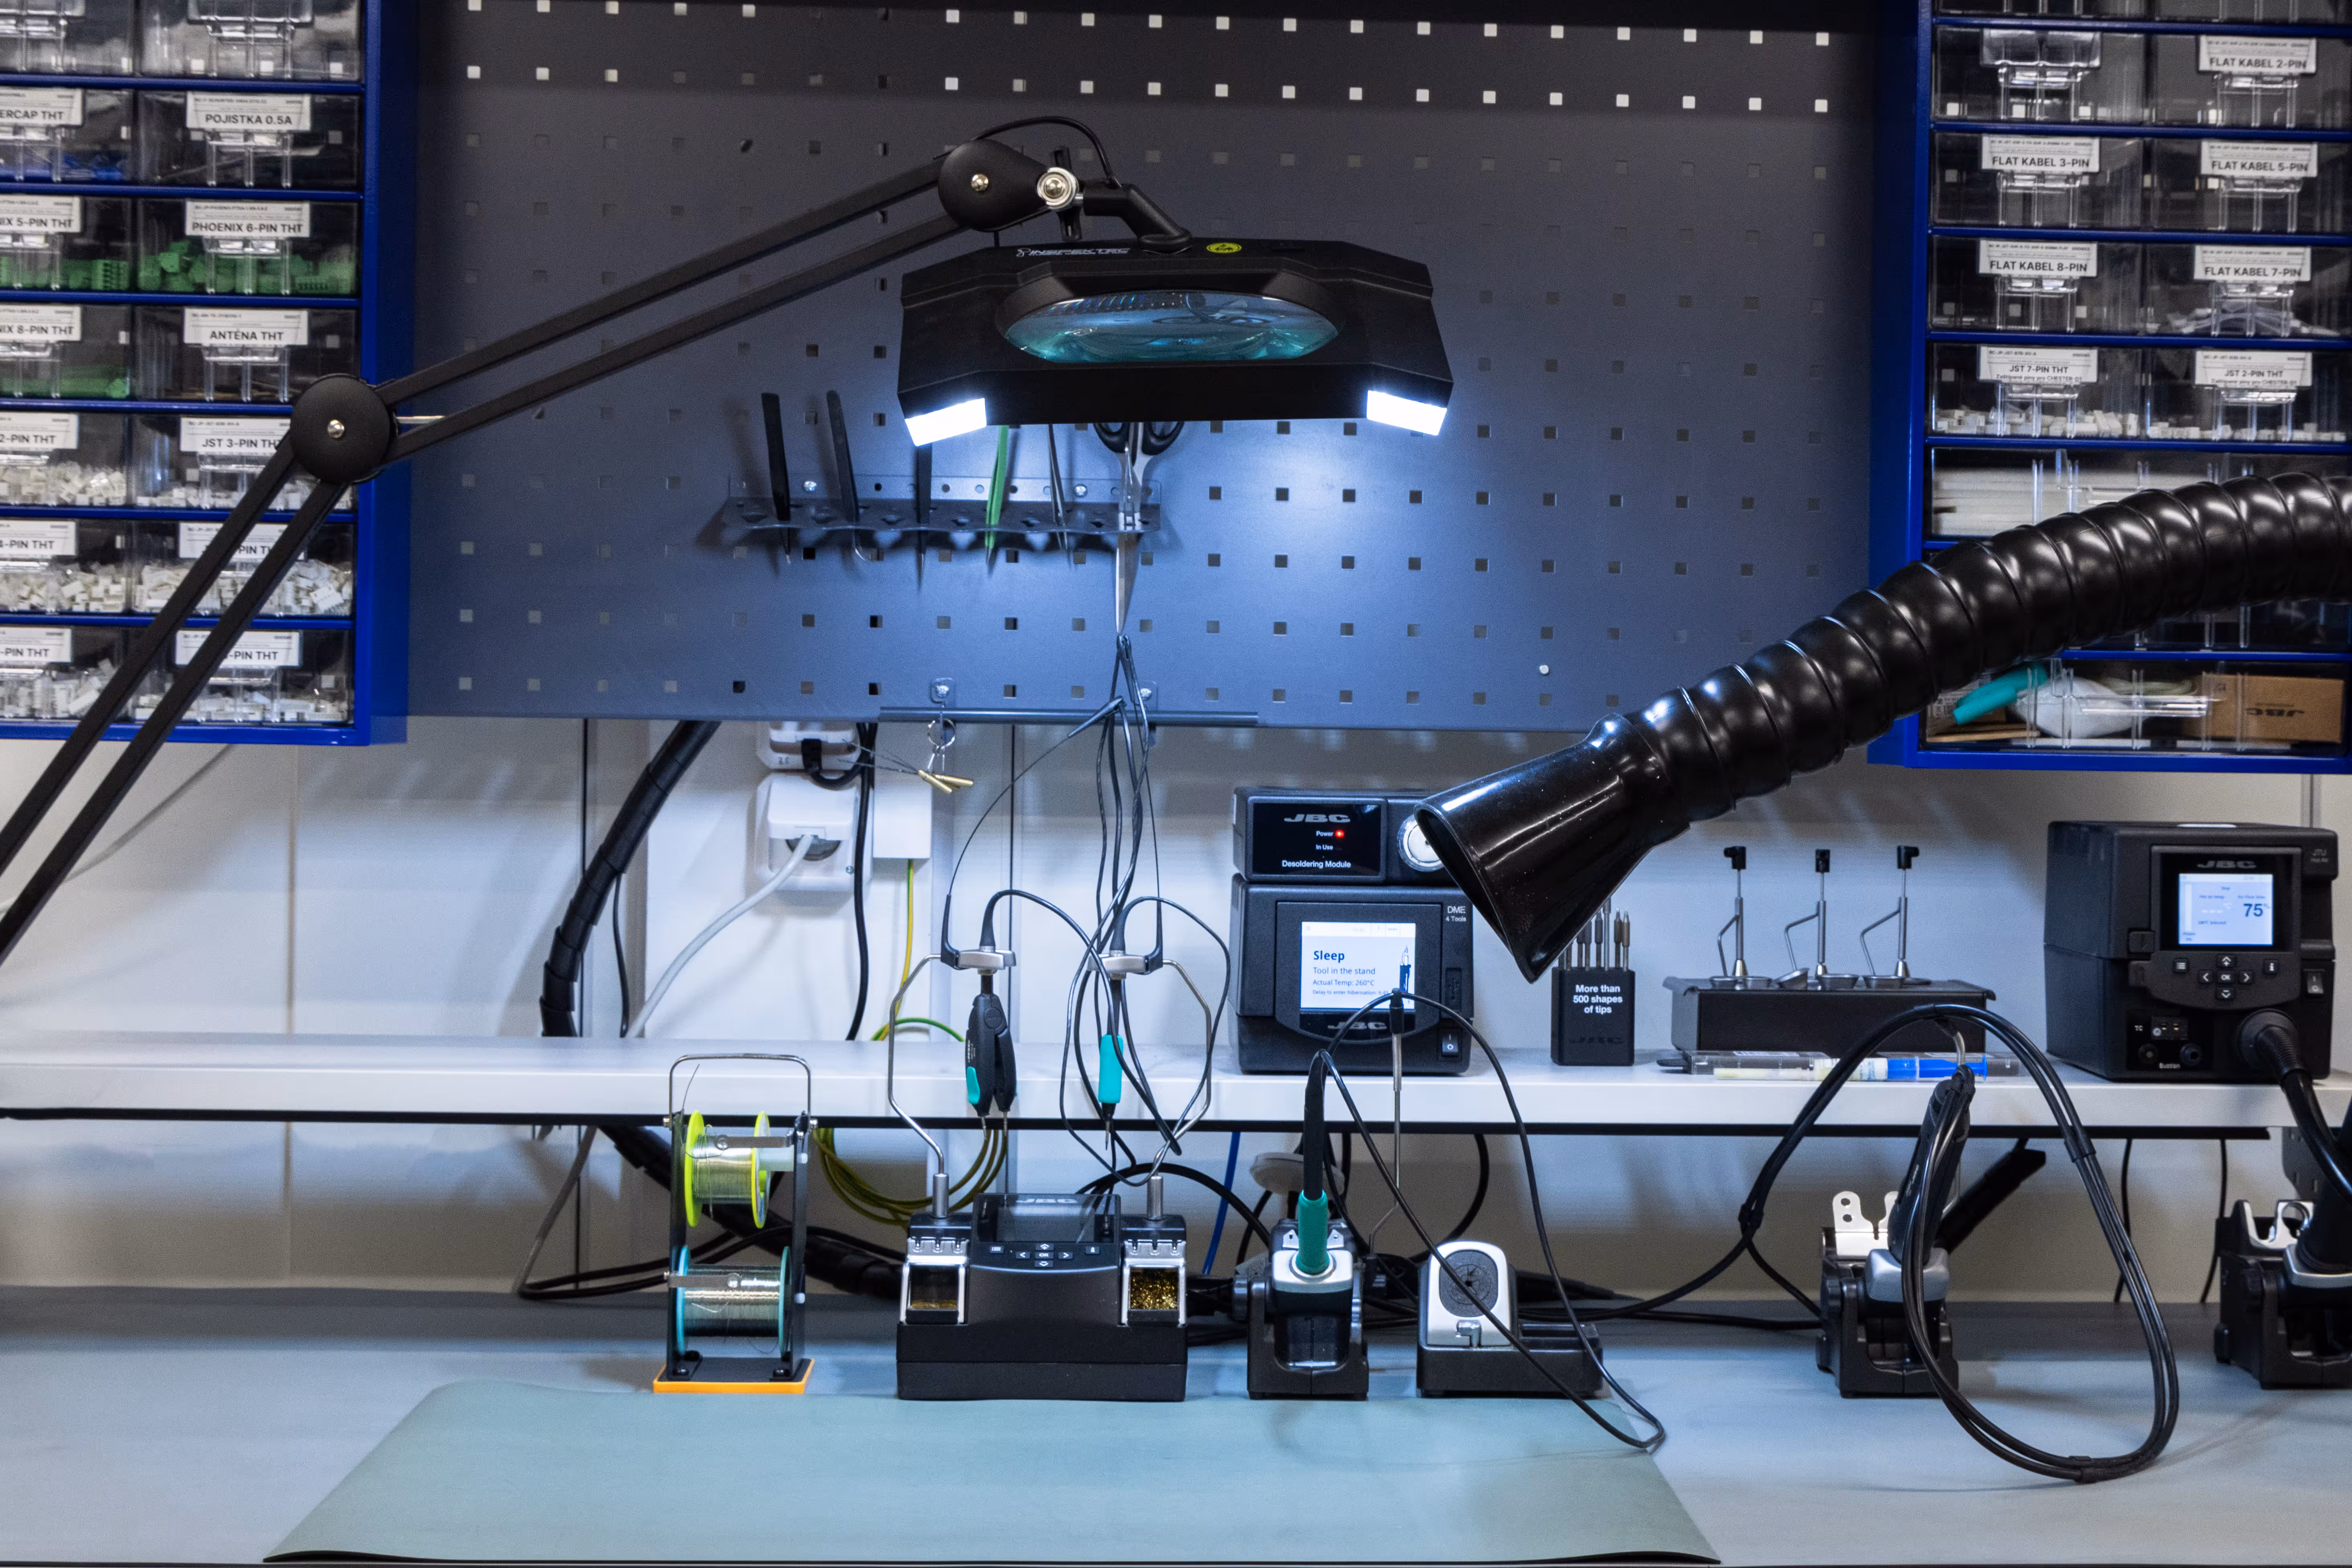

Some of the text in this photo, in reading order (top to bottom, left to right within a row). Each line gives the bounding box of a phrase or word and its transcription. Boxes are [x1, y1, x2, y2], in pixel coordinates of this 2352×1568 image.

[2210, 57, 2307, 69] FLAT KABEL 2-PIN
[41, 110, 63, 120] THT
[205, 114, 292, 125] POJISTKA 0.5A
[1992, 156, 2089, 167] FLAT KABEL 3-PIN
[2211, 161, 2238, 170] FLAT
[2241, 161, 2275, 171] KABEL
[52, 218, 73, 228] THT
[192, 222, 303, 233] PHOENIX 6-PIN THT
[1990, 260, 2087, 272] FLAT KABEL 8-PIN
[2205, 267, 2302, 277] FLAT KABEL 7-PIN
[52, 326, 74, 335] THT
[261, 332, 284, 341] THT
[2027, 365, 2049, 373] 7-PIN
[33, 435, 55, 443] THT
[202, 438, 223, 447] JST
[227, 439, 257, 448] 3-PIN
[32, 540, 55, 549] THT
[27, 648, 49, 657] THT
[229, 651, 278, 660] -PIN THT
[1284, 814, 1350, 823] JBC
[1282, 860, 1323, 869] Desoldering
[2197, 860, 2257, 868] JBC
[1447, 906, 1466, 914] DME
[2243, 903, 2264, 917] 75
[1313, 950, 1345, 964] Sleep
[1575, 984, 1621, 992] More than
[1573, 995, 1623, 1004] 500 shapes
[1584, 1005, 1612, 1015] of tips
